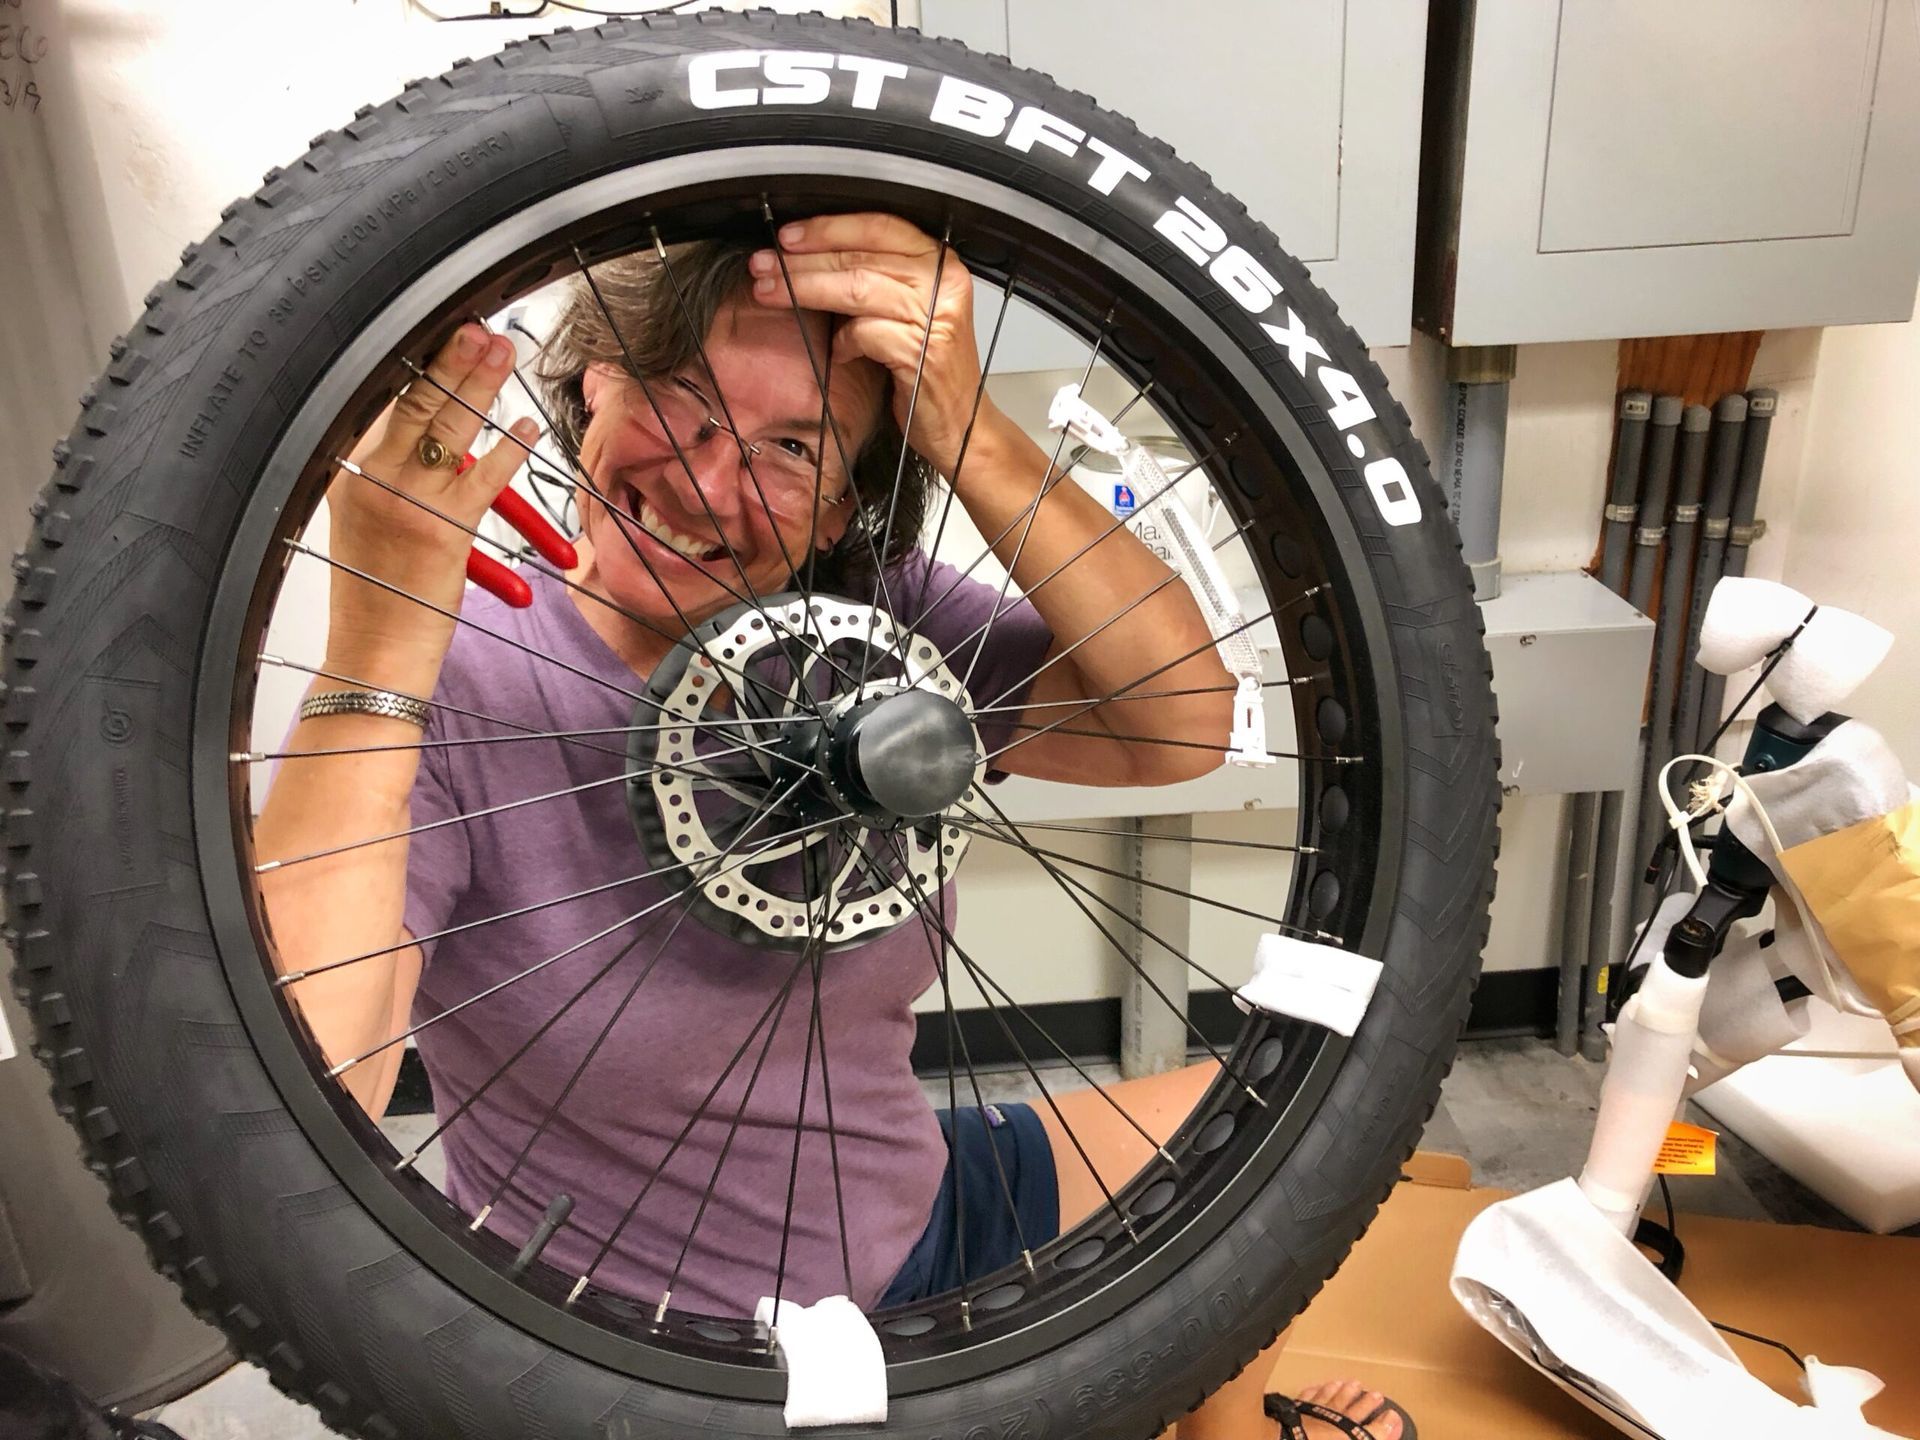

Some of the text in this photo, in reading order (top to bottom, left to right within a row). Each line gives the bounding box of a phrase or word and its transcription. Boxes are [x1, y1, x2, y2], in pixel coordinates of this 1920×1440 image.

[688, 49, 908, 110] CST
[930, 75, 1152, 196] BFT
[180, 364, 244, 459] INFLATE
[240, 329, 268, 361] TO
